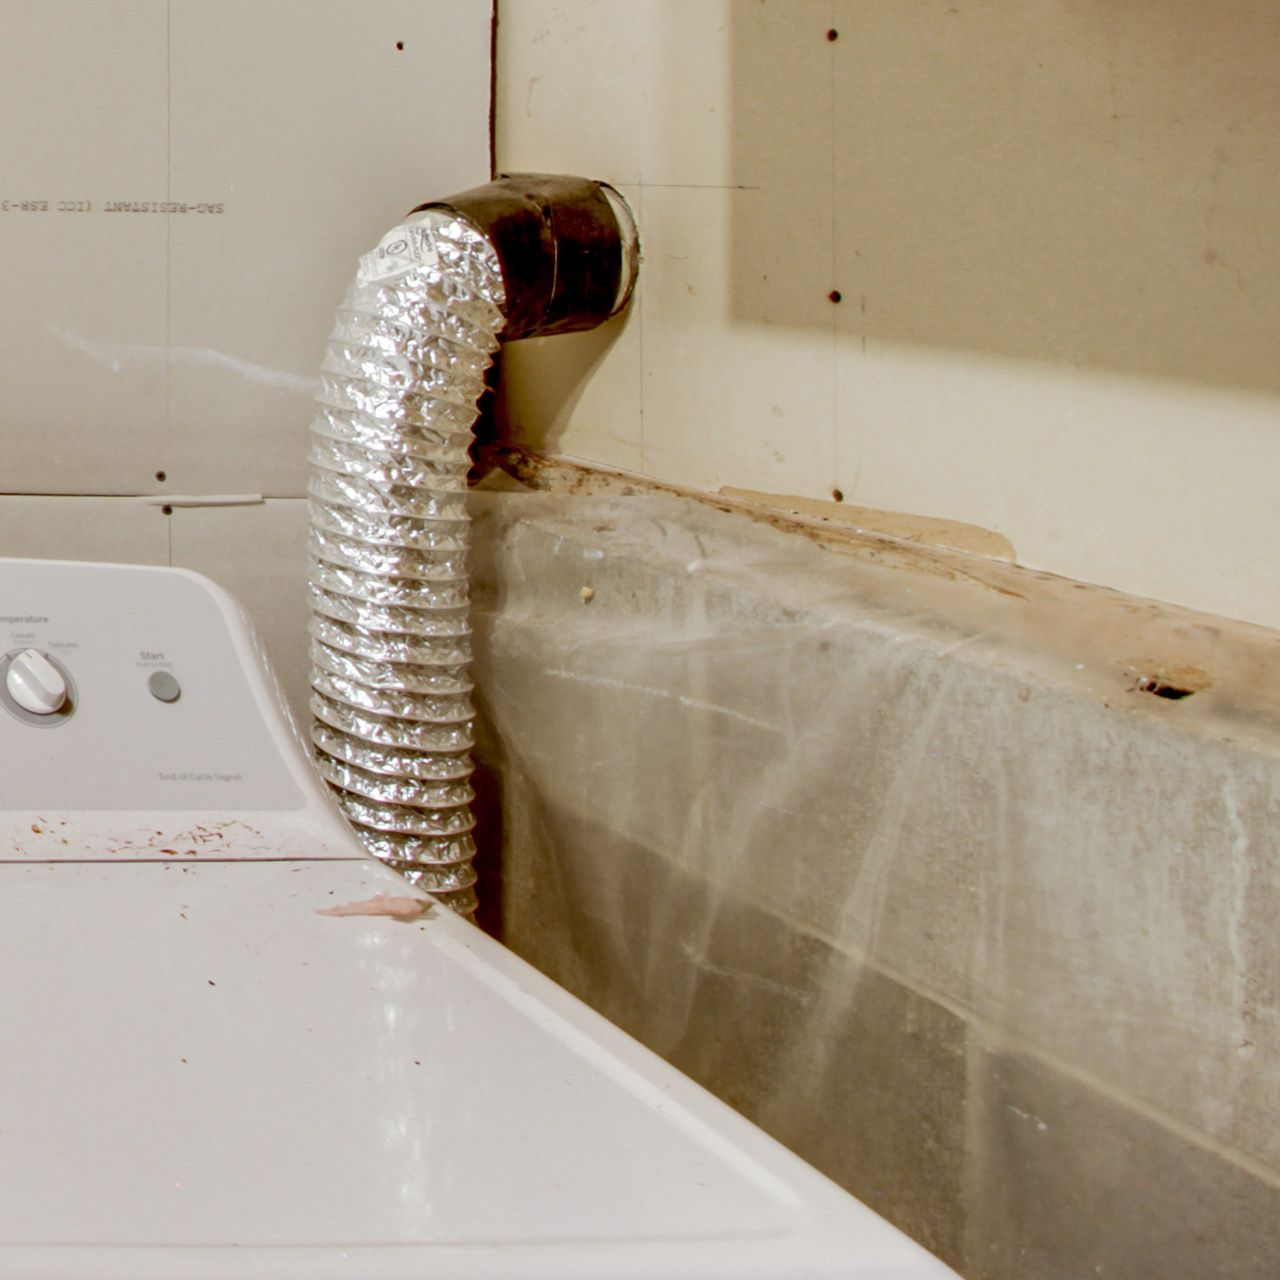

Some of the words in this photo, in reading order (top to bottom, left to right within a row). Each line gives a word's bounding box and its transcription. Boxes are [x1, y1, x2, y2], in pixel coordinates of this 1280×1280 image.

[56, 200, 92, 213] (ICC
[103, 200, 225, 214] SAG-RESISTANT
[139, 651, 165, 661] Start
